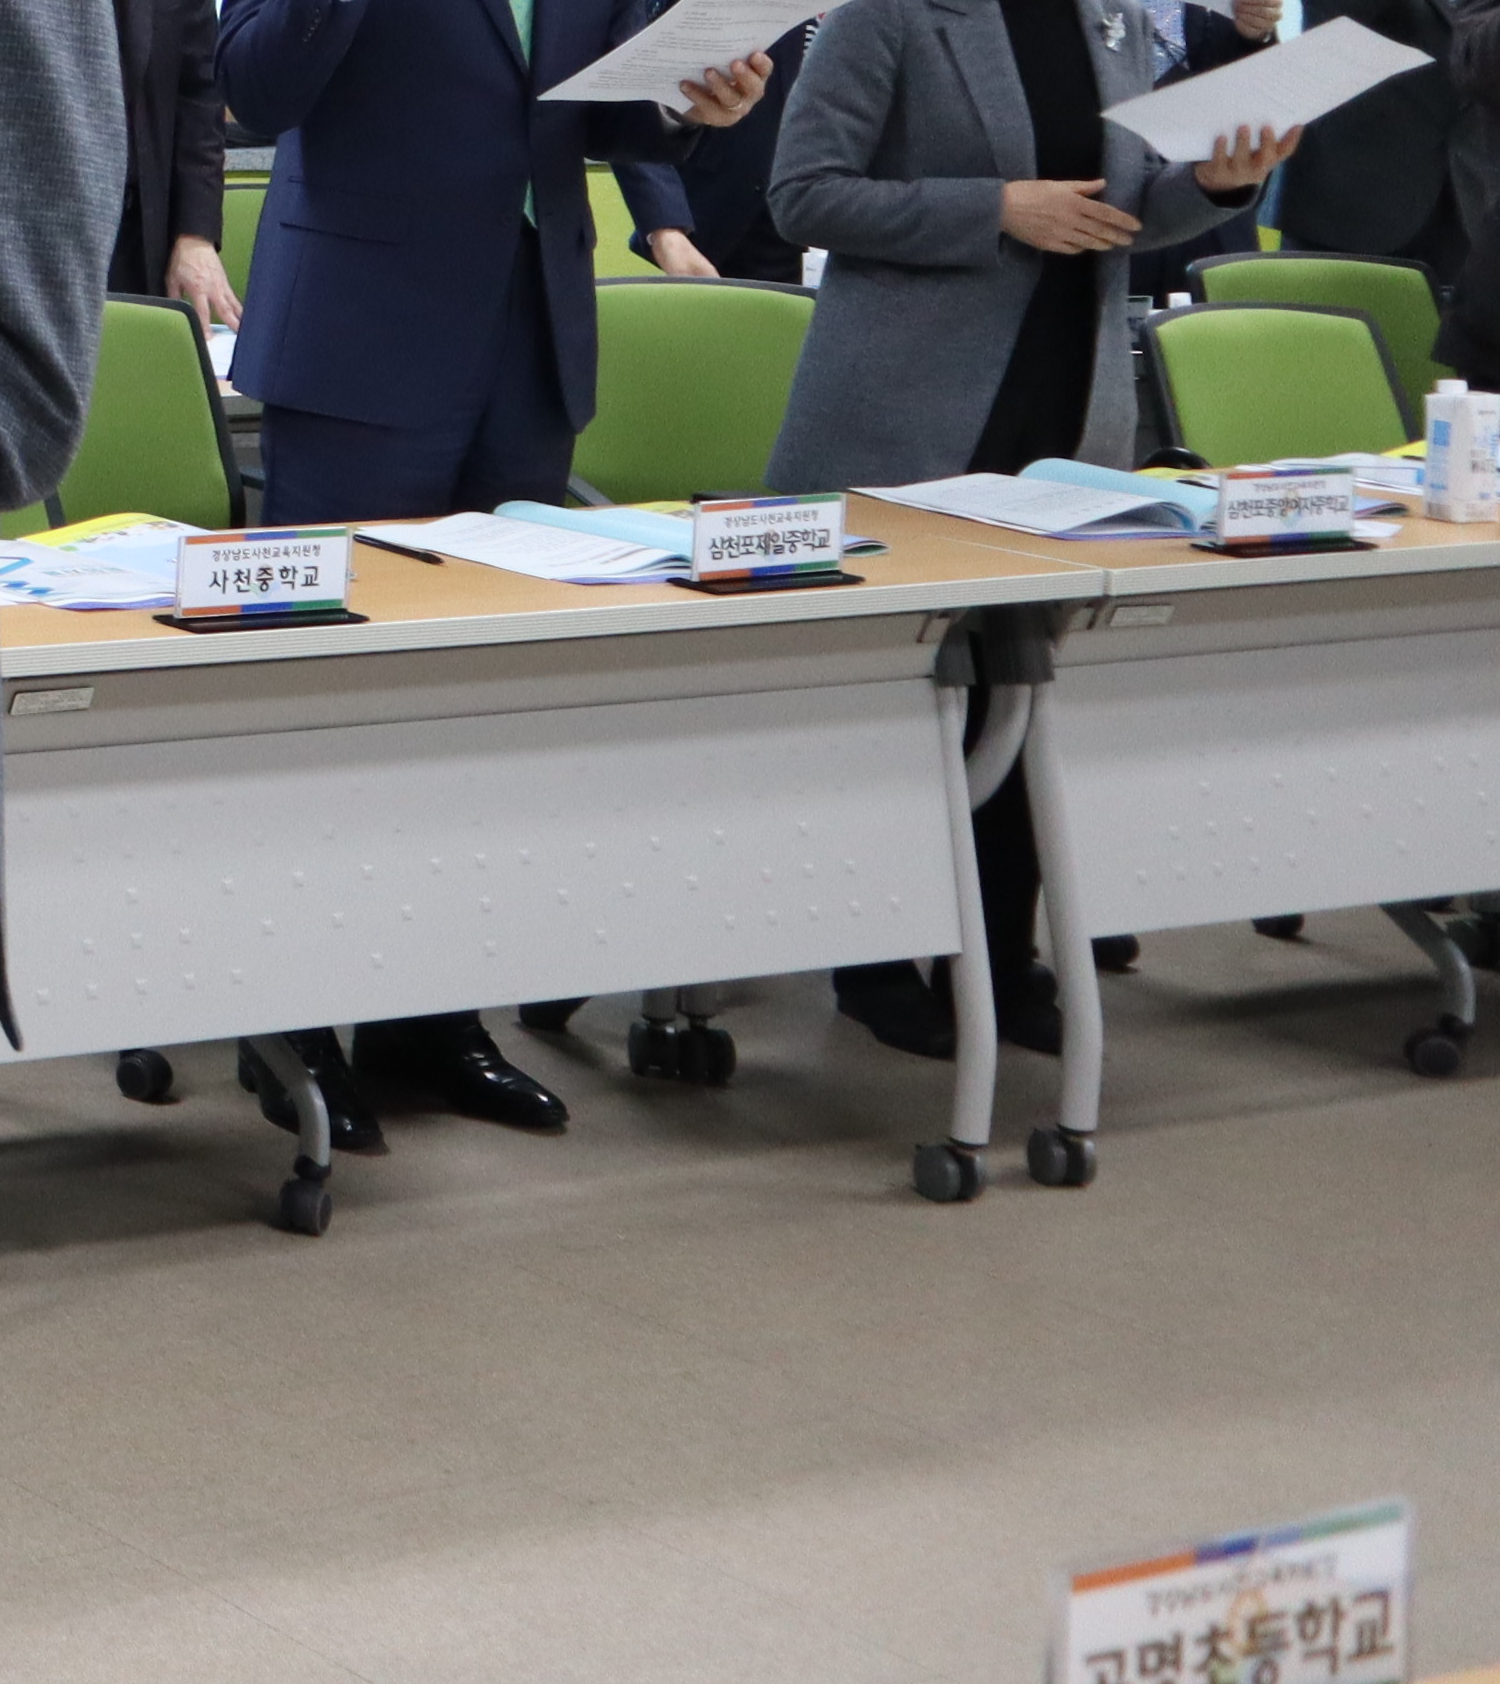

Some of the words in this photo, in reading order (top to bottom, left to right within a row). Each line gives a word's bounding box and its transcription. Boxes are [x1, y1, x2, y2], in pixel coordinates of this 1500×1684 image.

[211, 544, 321, 562] 경상남도사천교육지원청
[709, 528, 831, 560] 삼천포제일중학교
[208, 565, 321, 594] 사천중학교
